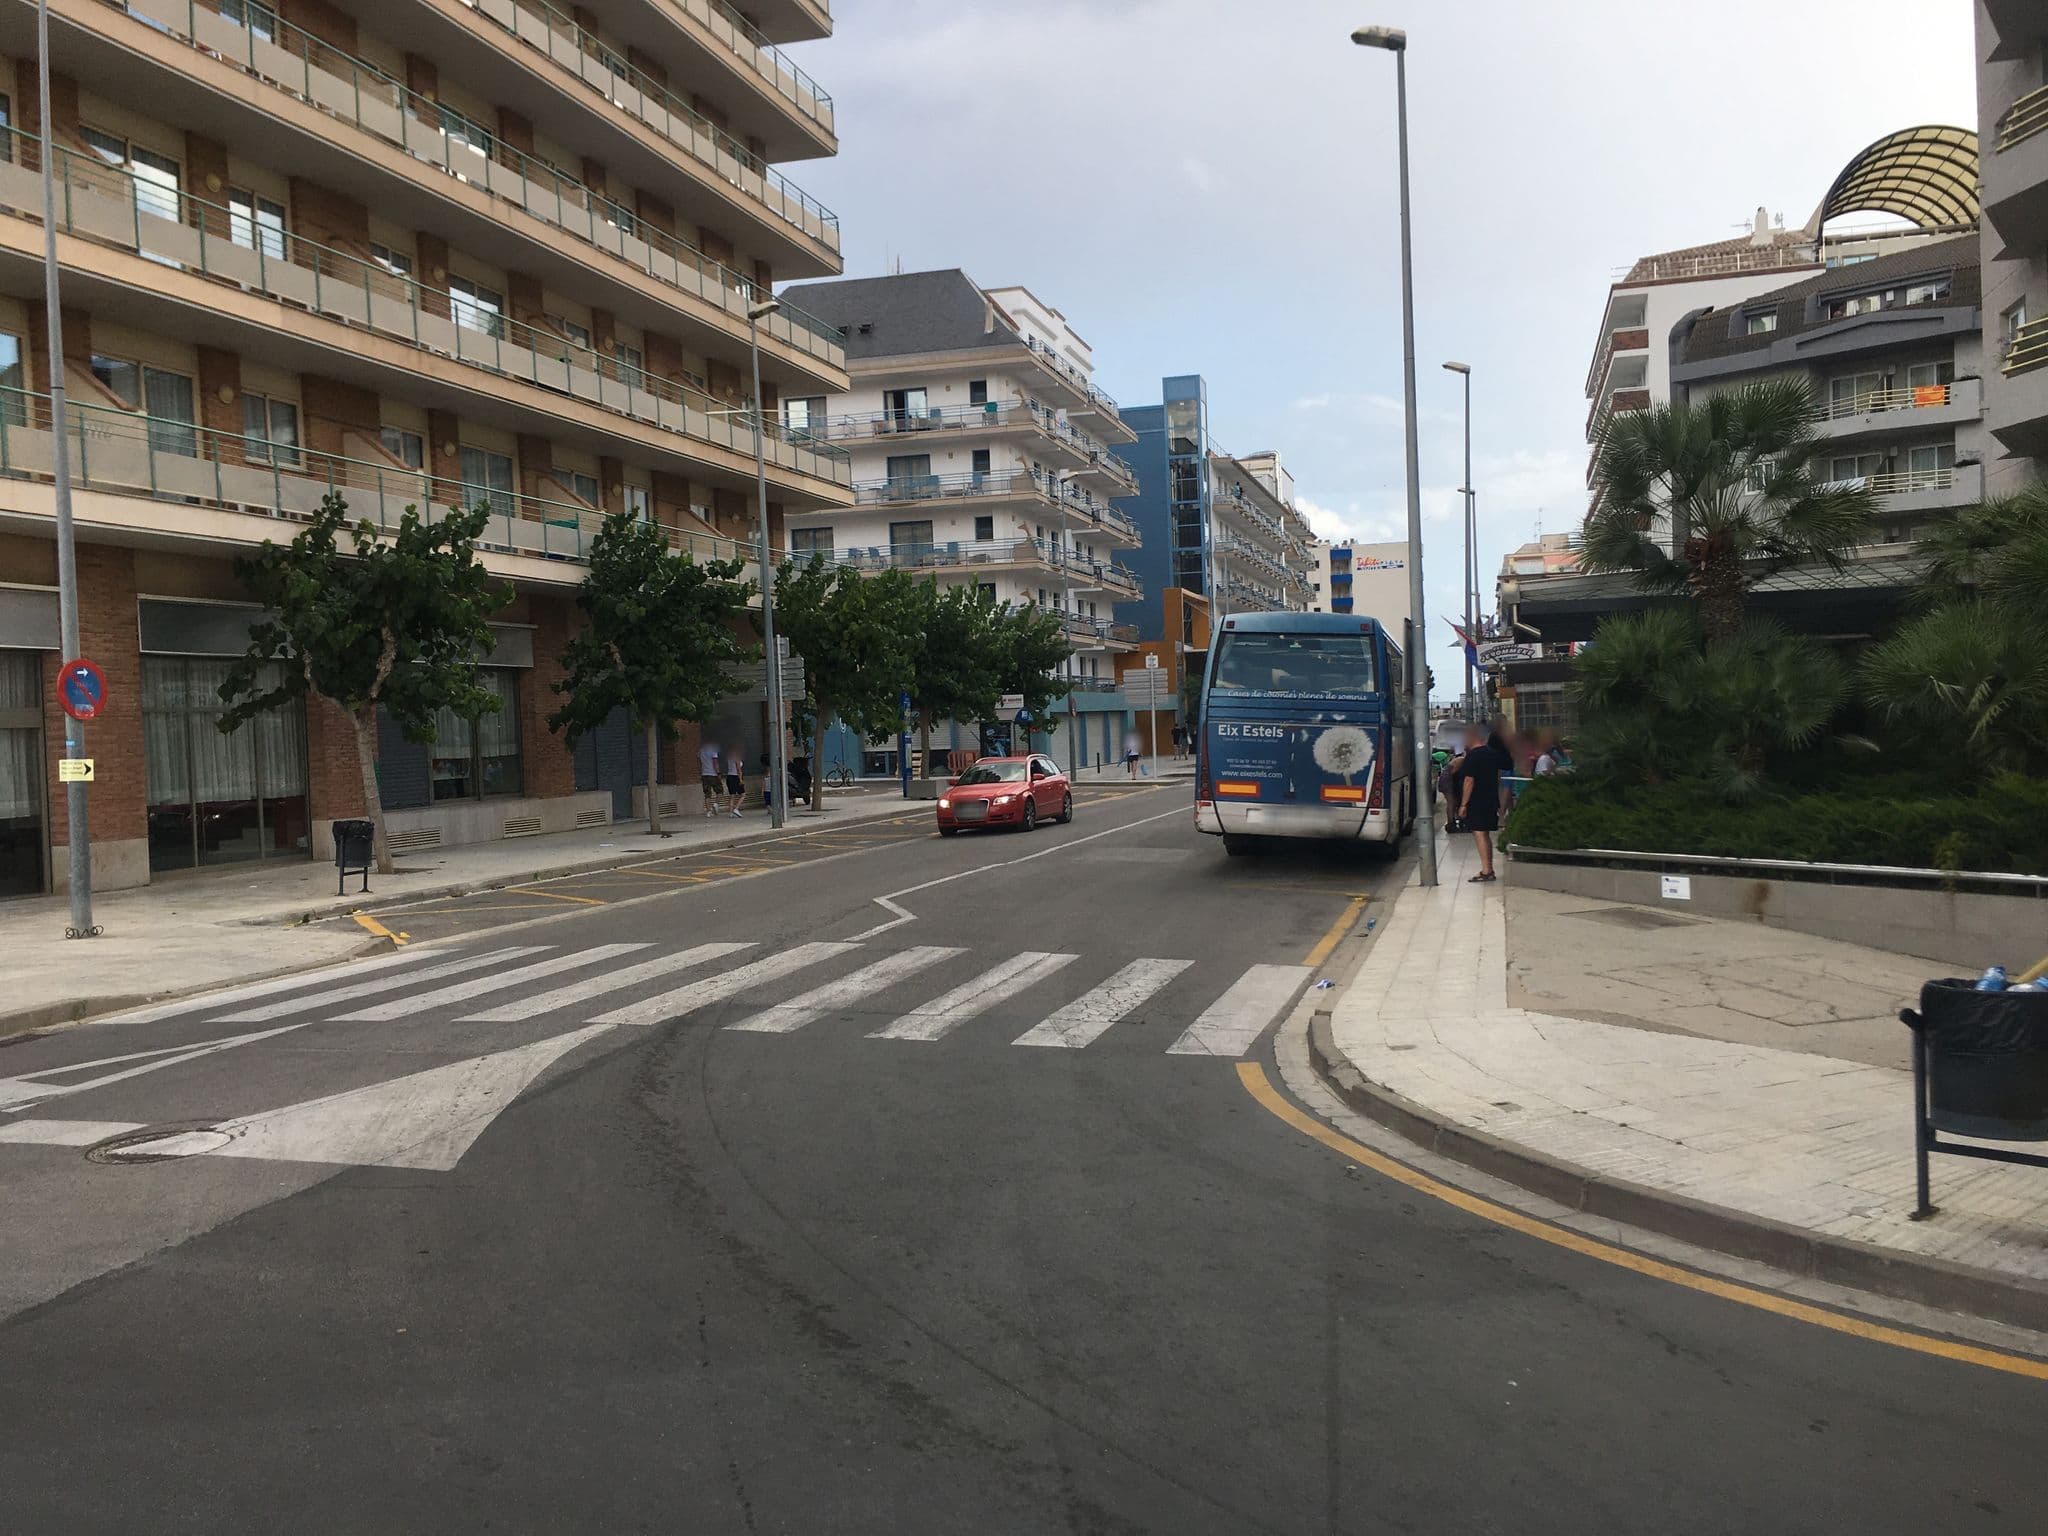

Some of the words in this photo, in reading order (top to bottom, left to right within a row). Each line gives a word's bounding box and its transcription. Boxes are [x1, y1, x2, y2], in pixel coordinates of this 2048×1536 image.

[1251, 689, 1262, 698] de
[1325, 691, 1337, 700] de
[1218, 724, 1239, 736] Eix
[1243, 725, 1284, 738] Estels
[1221, 769, 1283, 779] www.eixestels.com
